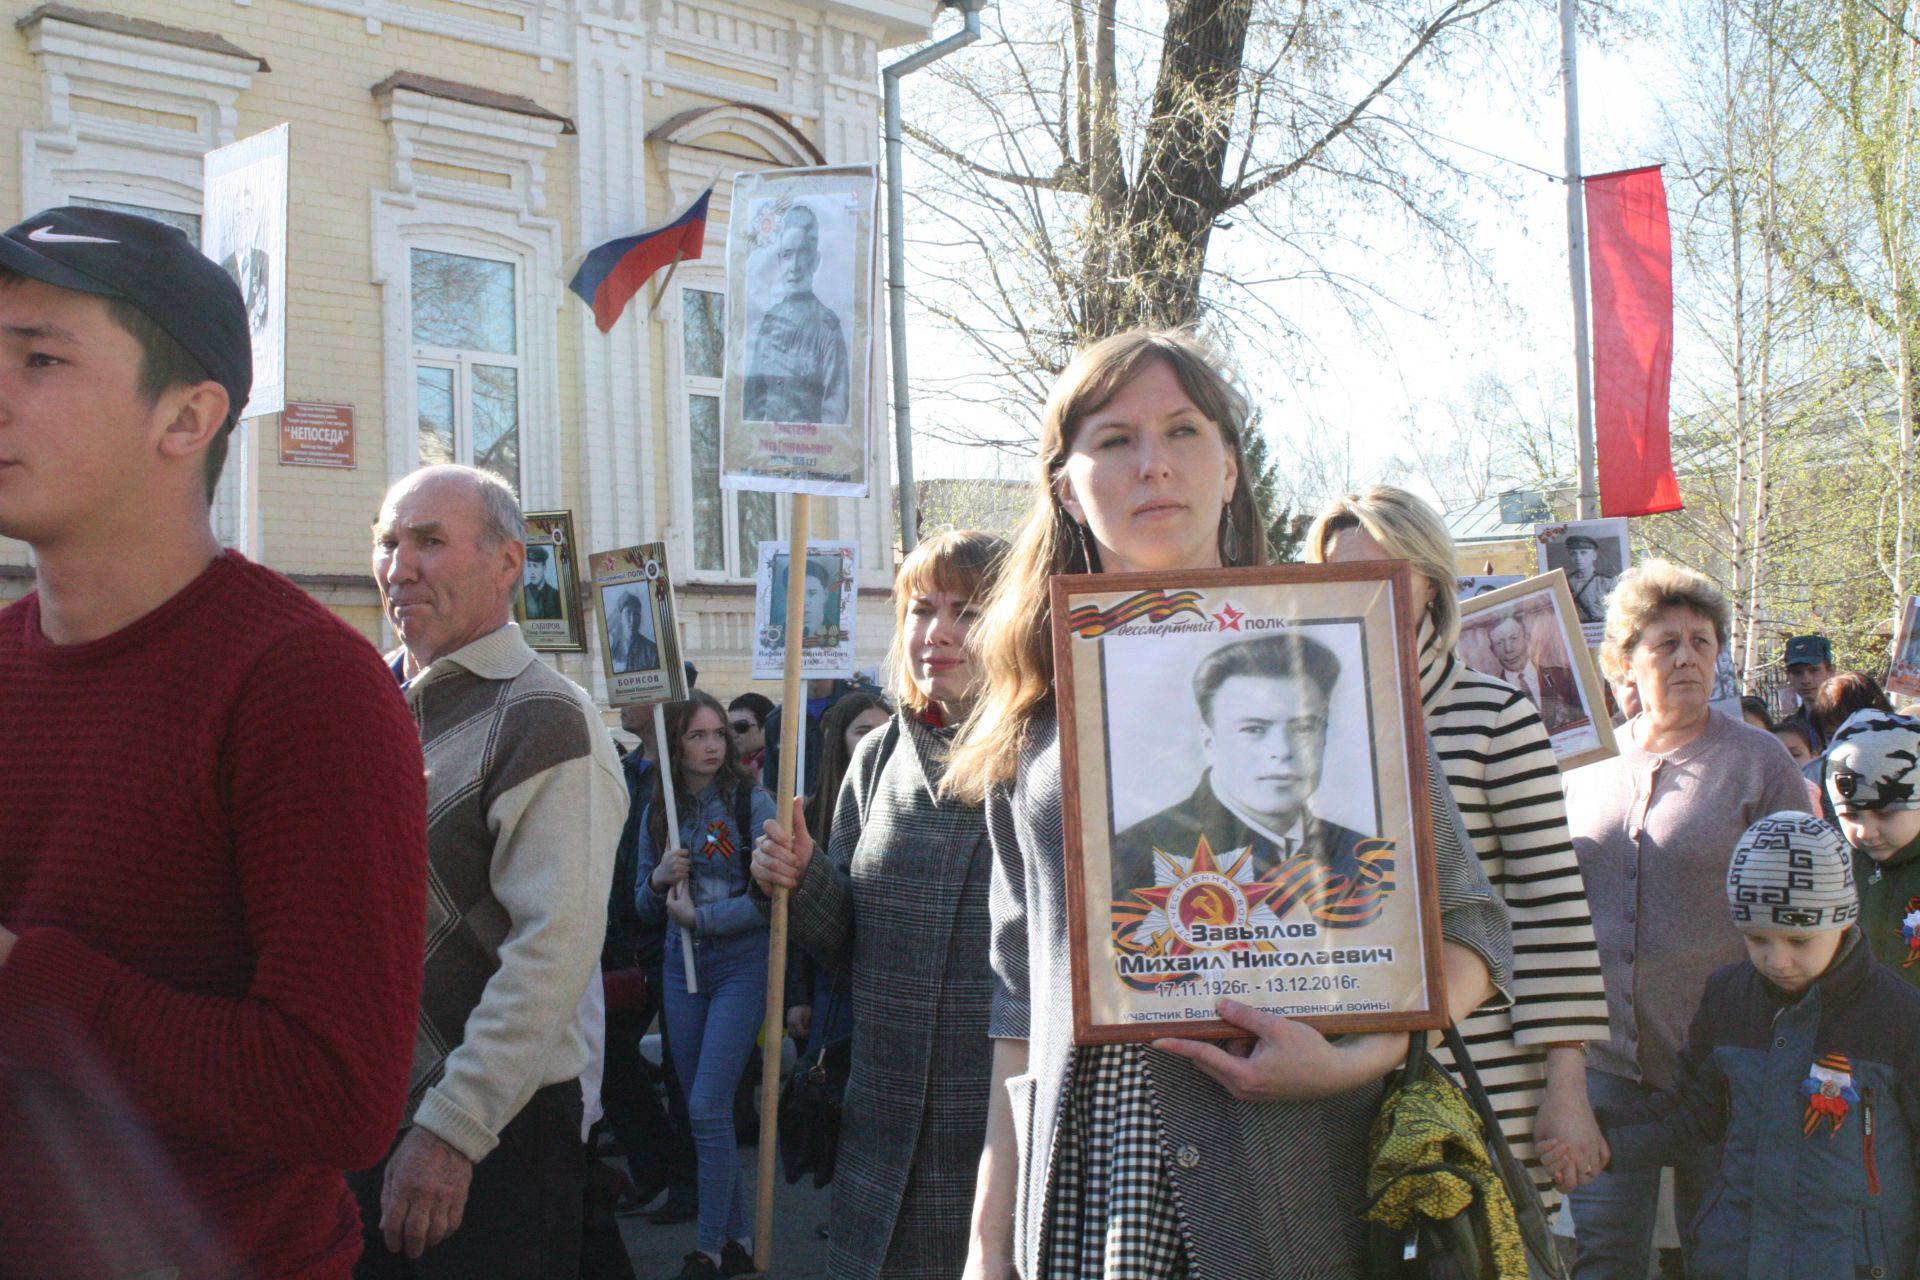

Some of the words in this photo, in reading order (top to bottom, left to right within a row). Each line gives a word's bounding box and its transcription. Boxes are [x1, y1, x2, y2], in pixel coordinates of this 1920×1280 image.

[617, 674, 659, 687] БОРИСОВ
[1191, 922, 1317, 943] Завьялов
[1119, 954, 1225, 974] Михаил
[1232, 947, 1394, 969] Николаевич
[1155, 979, 1251, 998] 17.11.1926г.
[1267, 974, 1361, 993] 13.12.2016г.
[1346, 999, 1391, 1012] войны
